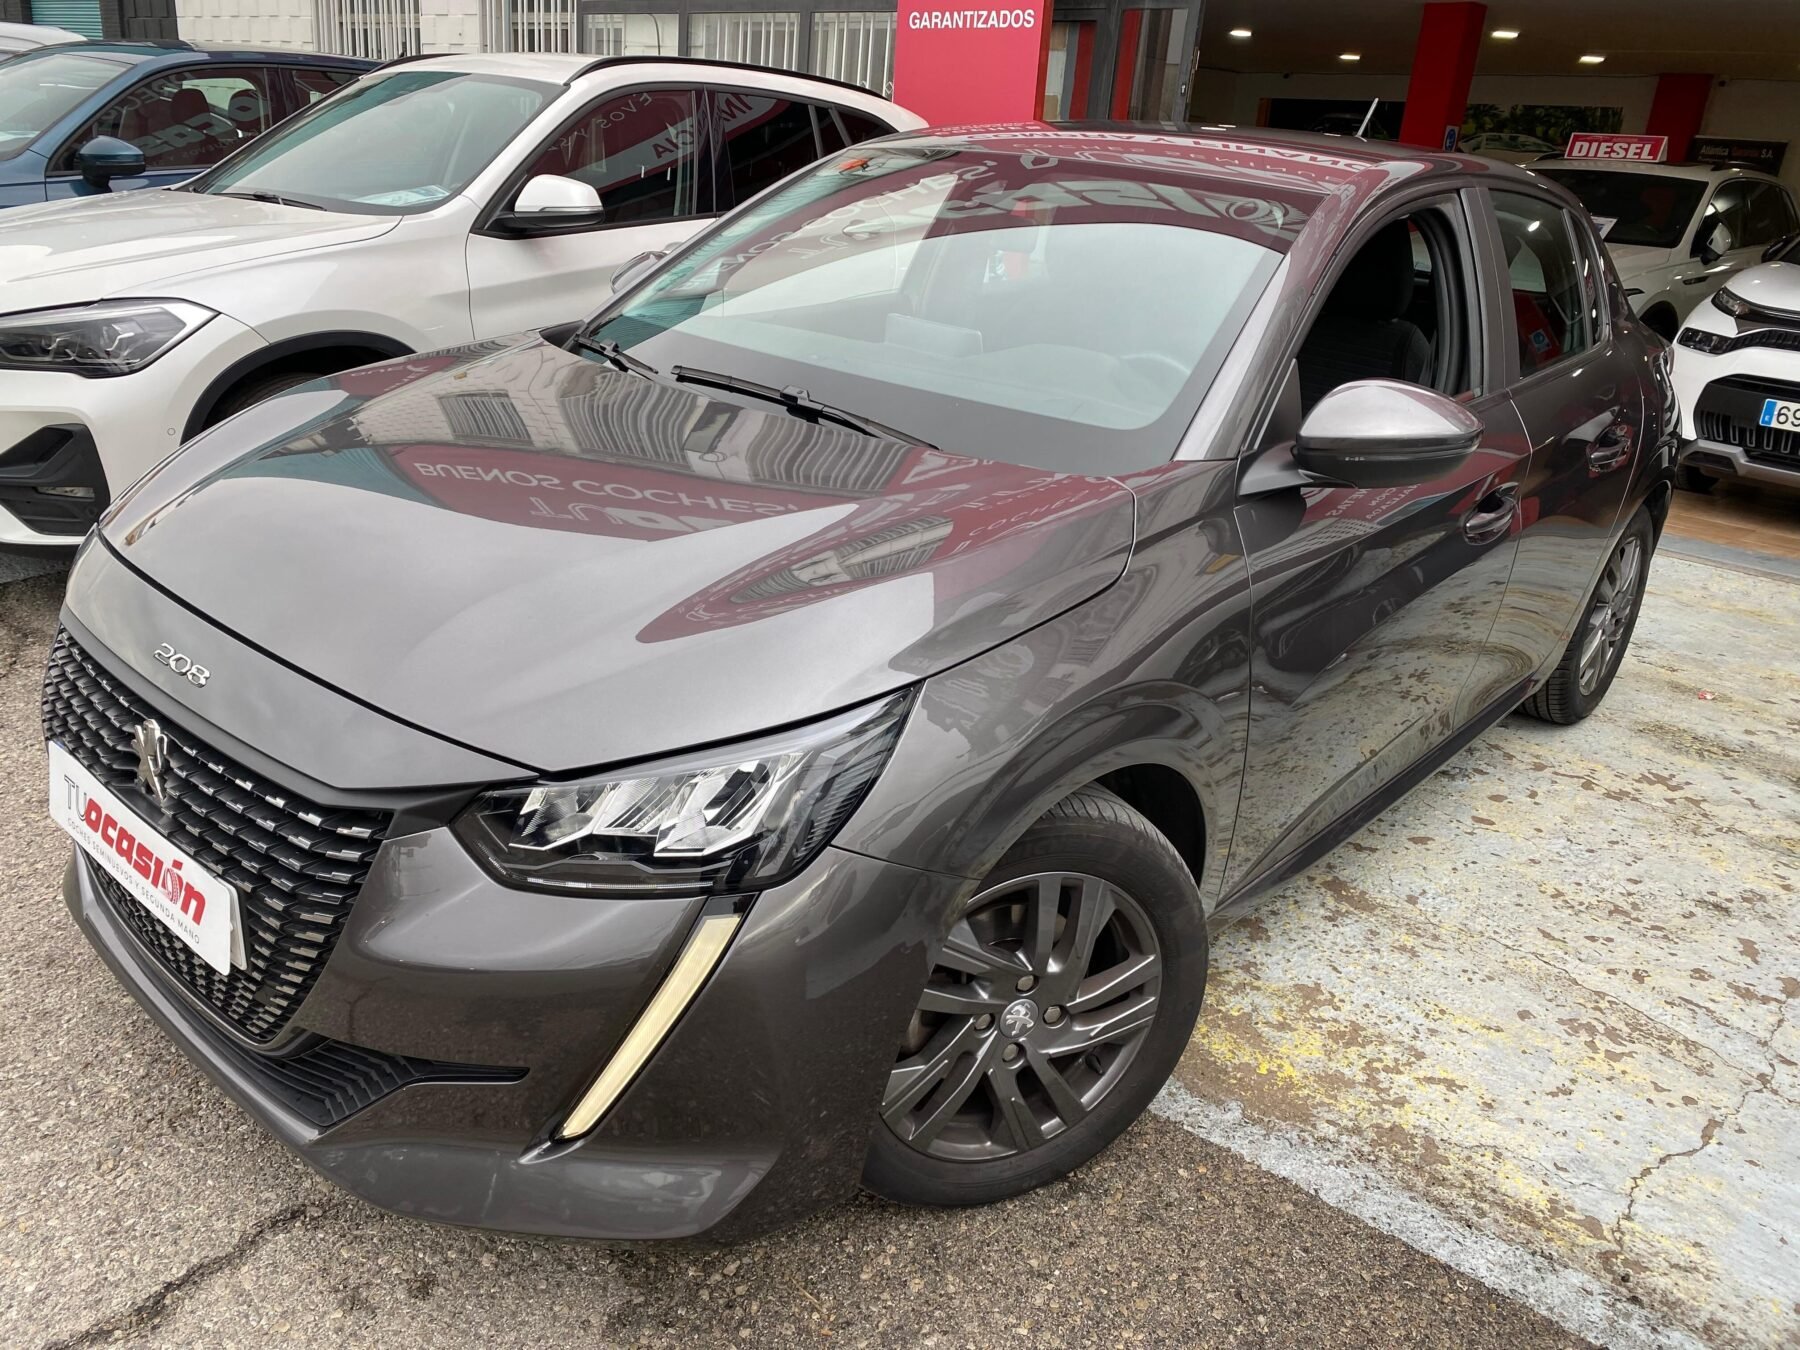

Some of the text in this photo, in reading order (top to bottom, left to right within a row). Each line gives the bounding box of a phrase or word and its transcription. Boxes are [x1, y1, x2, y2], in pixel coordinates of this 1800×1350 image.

[909, 9, 1035, 29] GARANTIZADOS
[1571, 141, 1654, 160] DIESEL
[153, 642, 210, 688] 208
[67, 817, 91, 844] COCHES
[92, 842, 133, 884] SEMINUEVOS
[141, 886, 175, 922] SEGUNDA
[177, 921, 200, 944] MANO
